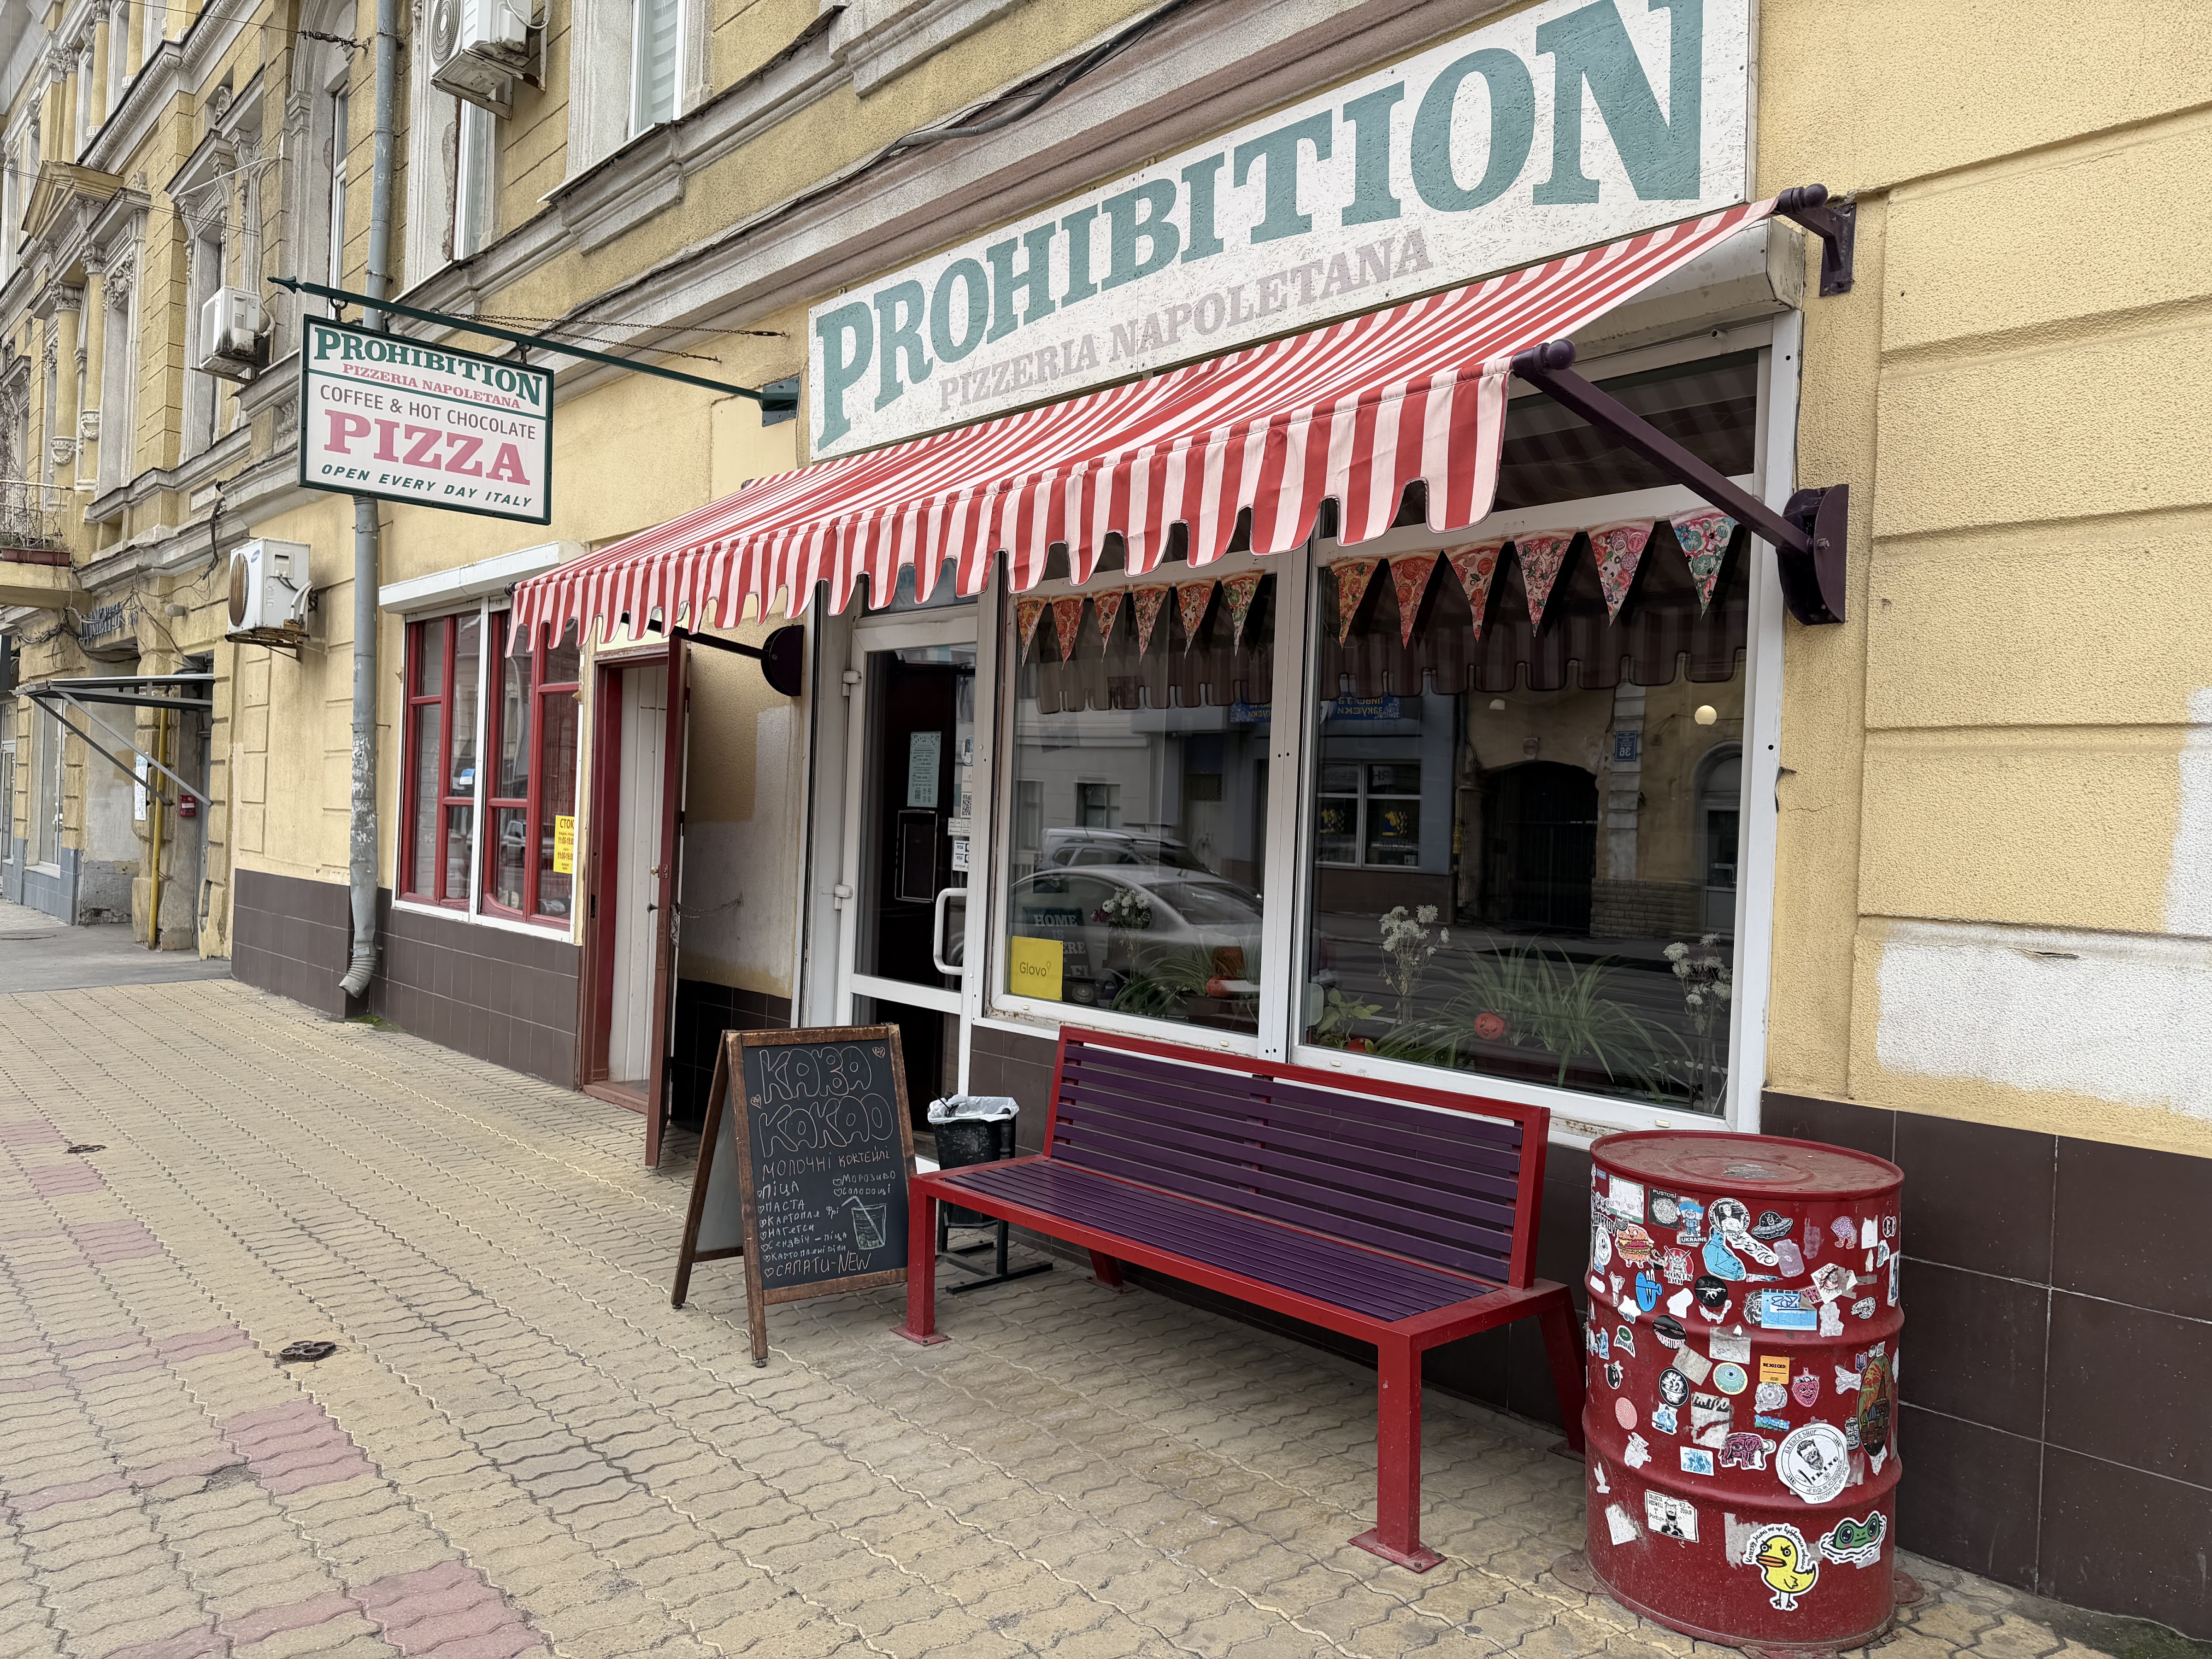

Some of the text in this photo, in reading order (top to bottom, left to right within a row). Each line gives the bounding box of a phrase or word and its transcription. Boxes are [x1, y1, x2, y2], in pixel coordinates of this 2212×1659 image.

[815, 0, 1702, 452] PROHIBITION
[940, 229, 1433, 412] PIZZERIA NAPOLETANA
[314, 327, 542, 406] PROHIBITION
[343, 363, 521, 409] PIZZERIA NAPOLETANA
[320, 384, 535, 440] COFFEE & HOT CHOCOLATE
[324, 409, 530, 486] PIZZA
[321, 464, 532, 507] OPEN EVERY DAY ITALY
[1034, 914, 1077, 927] HOME
[1052, 929, 1065, 940] IS
[1019, 962, 1047, 977] Glovo
[759, 1046, 872, 1104] КАВА
[759, 1094, 894, 1158] КАКАО
[763, 1153, 831, 1182] МОЛОЧНІ
[765, 1200, 805, 1212] ПАСТА
[1665, 1271, 1693, 1281] RONIN
[1784, 1429, 1817, 1454] BARBER SHOP
